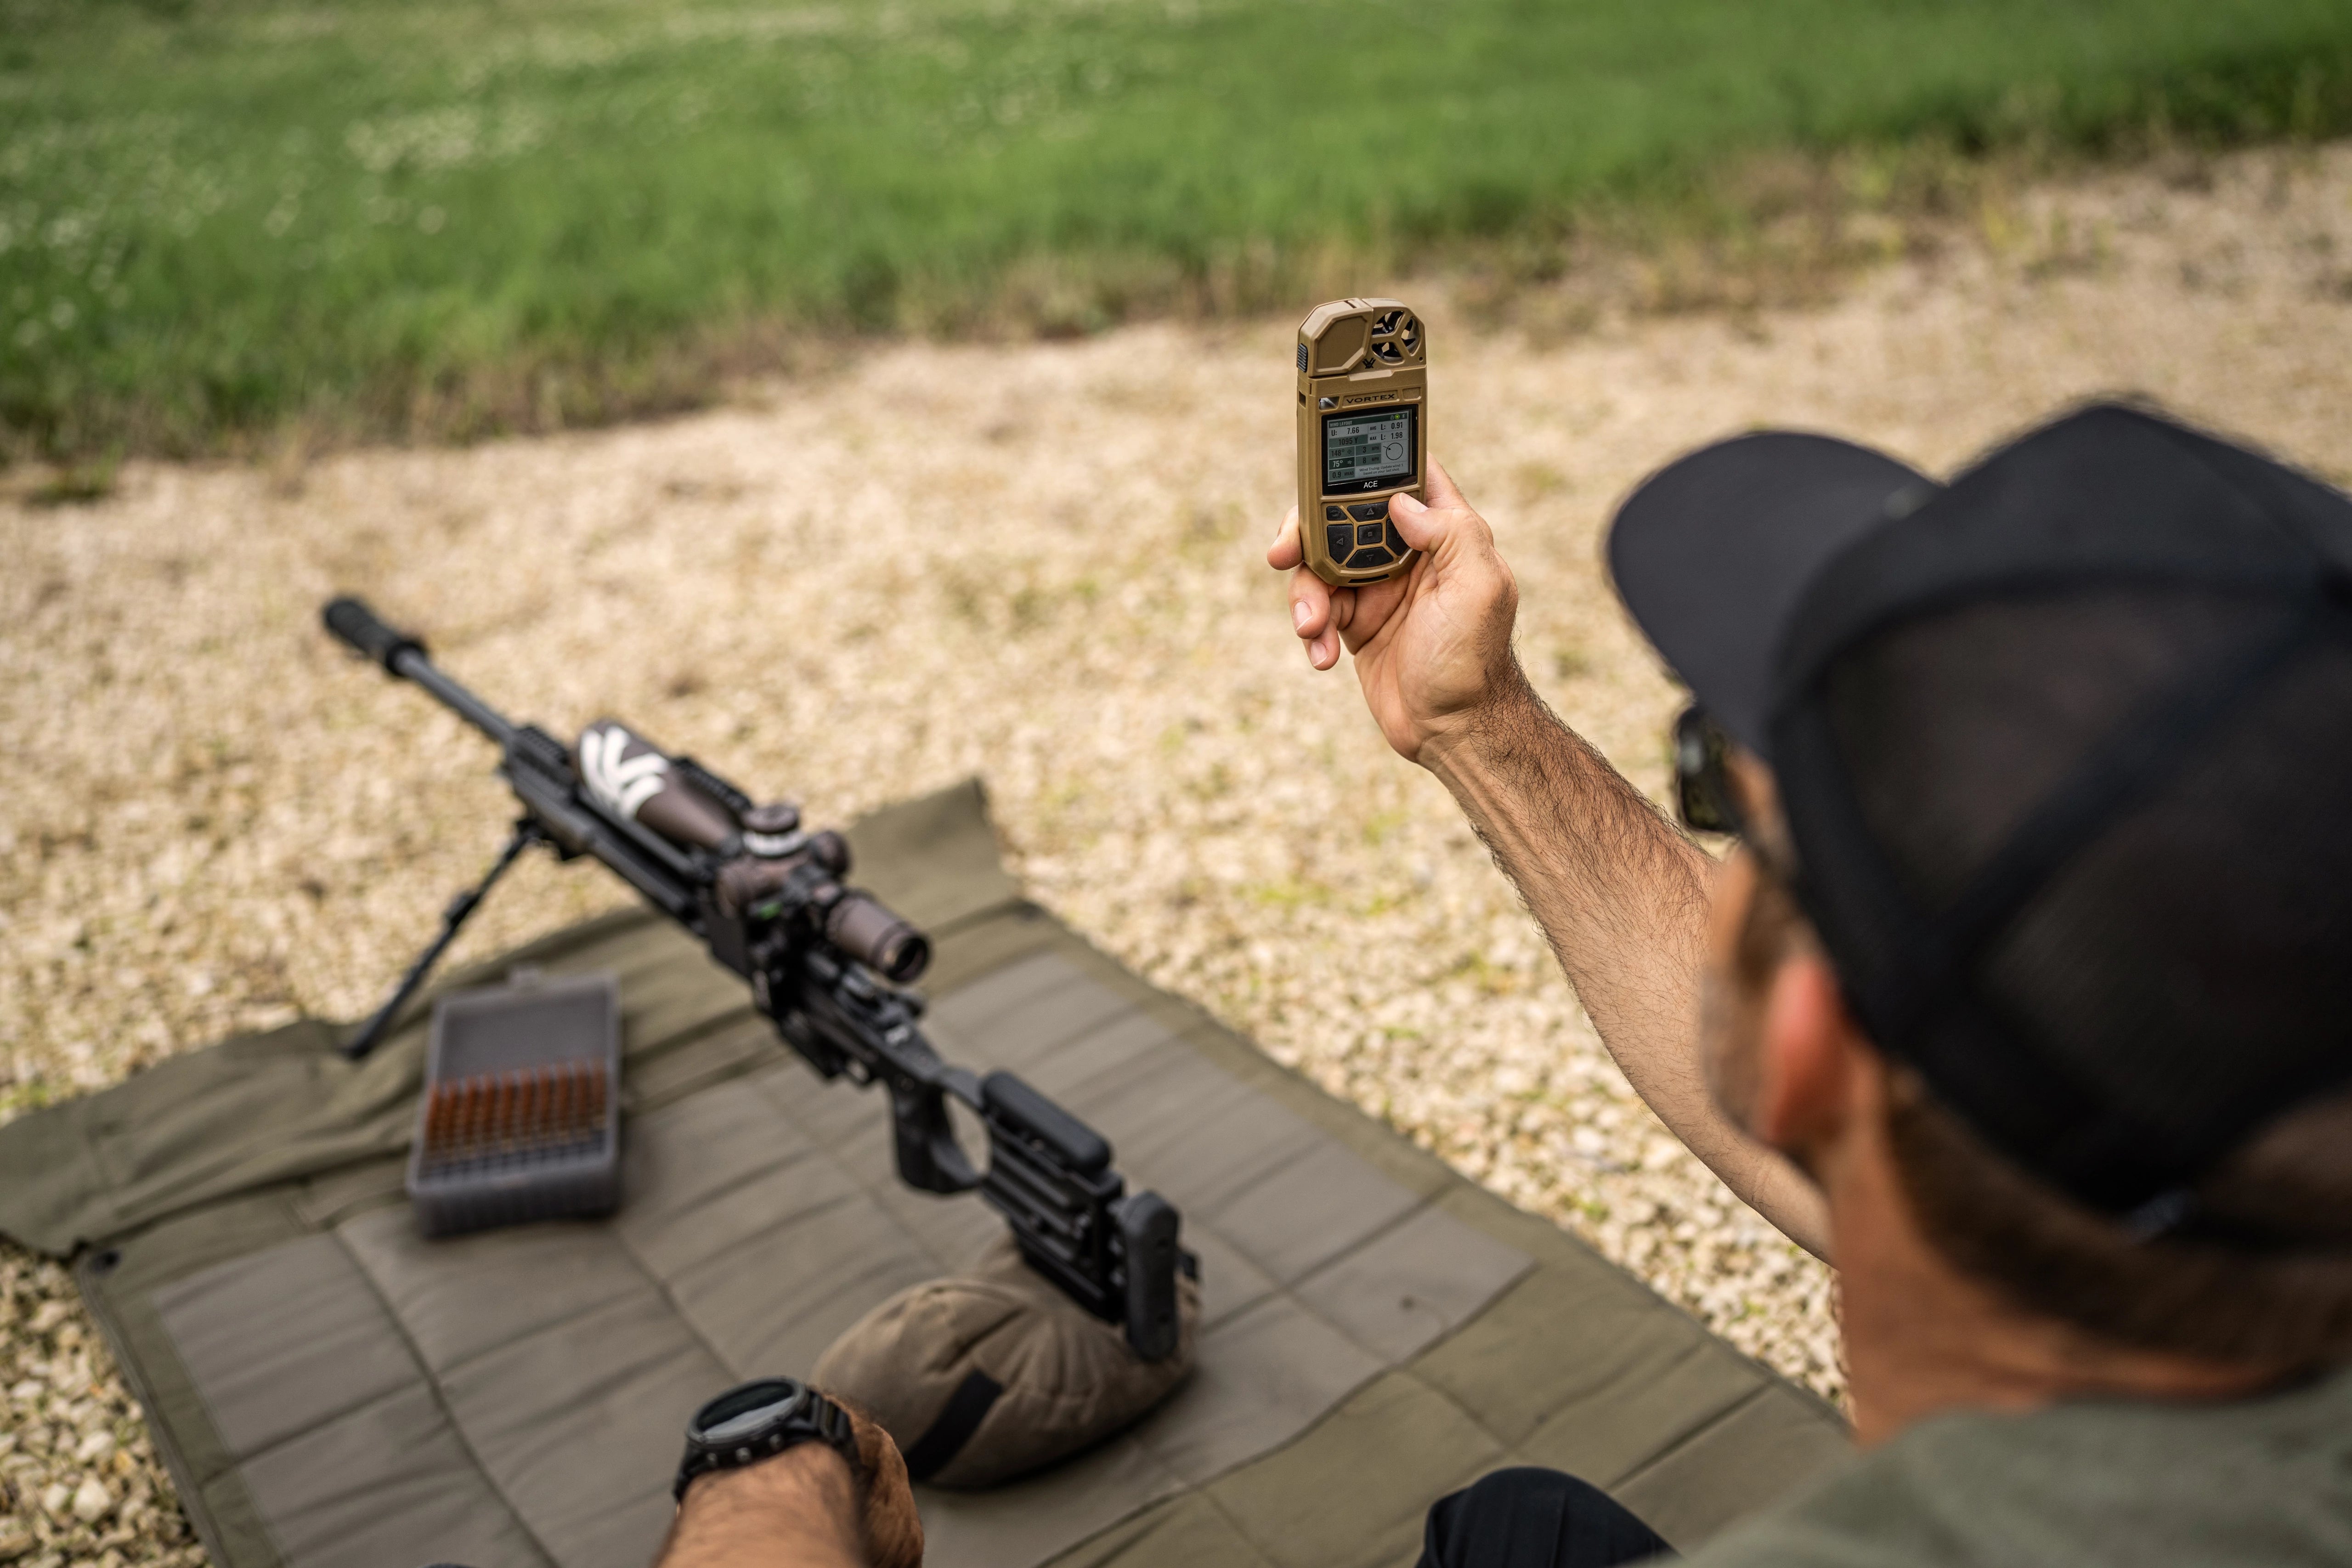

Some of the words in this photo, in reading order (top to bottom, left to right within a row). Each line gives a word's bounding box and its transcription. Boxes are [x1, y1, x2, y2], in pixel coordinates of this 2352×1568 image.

[1346, 394, 1395, 403] VORTEX
[1339, 437, 1353, 446] 1095
[1363, 480, 1378, 489] ACE
